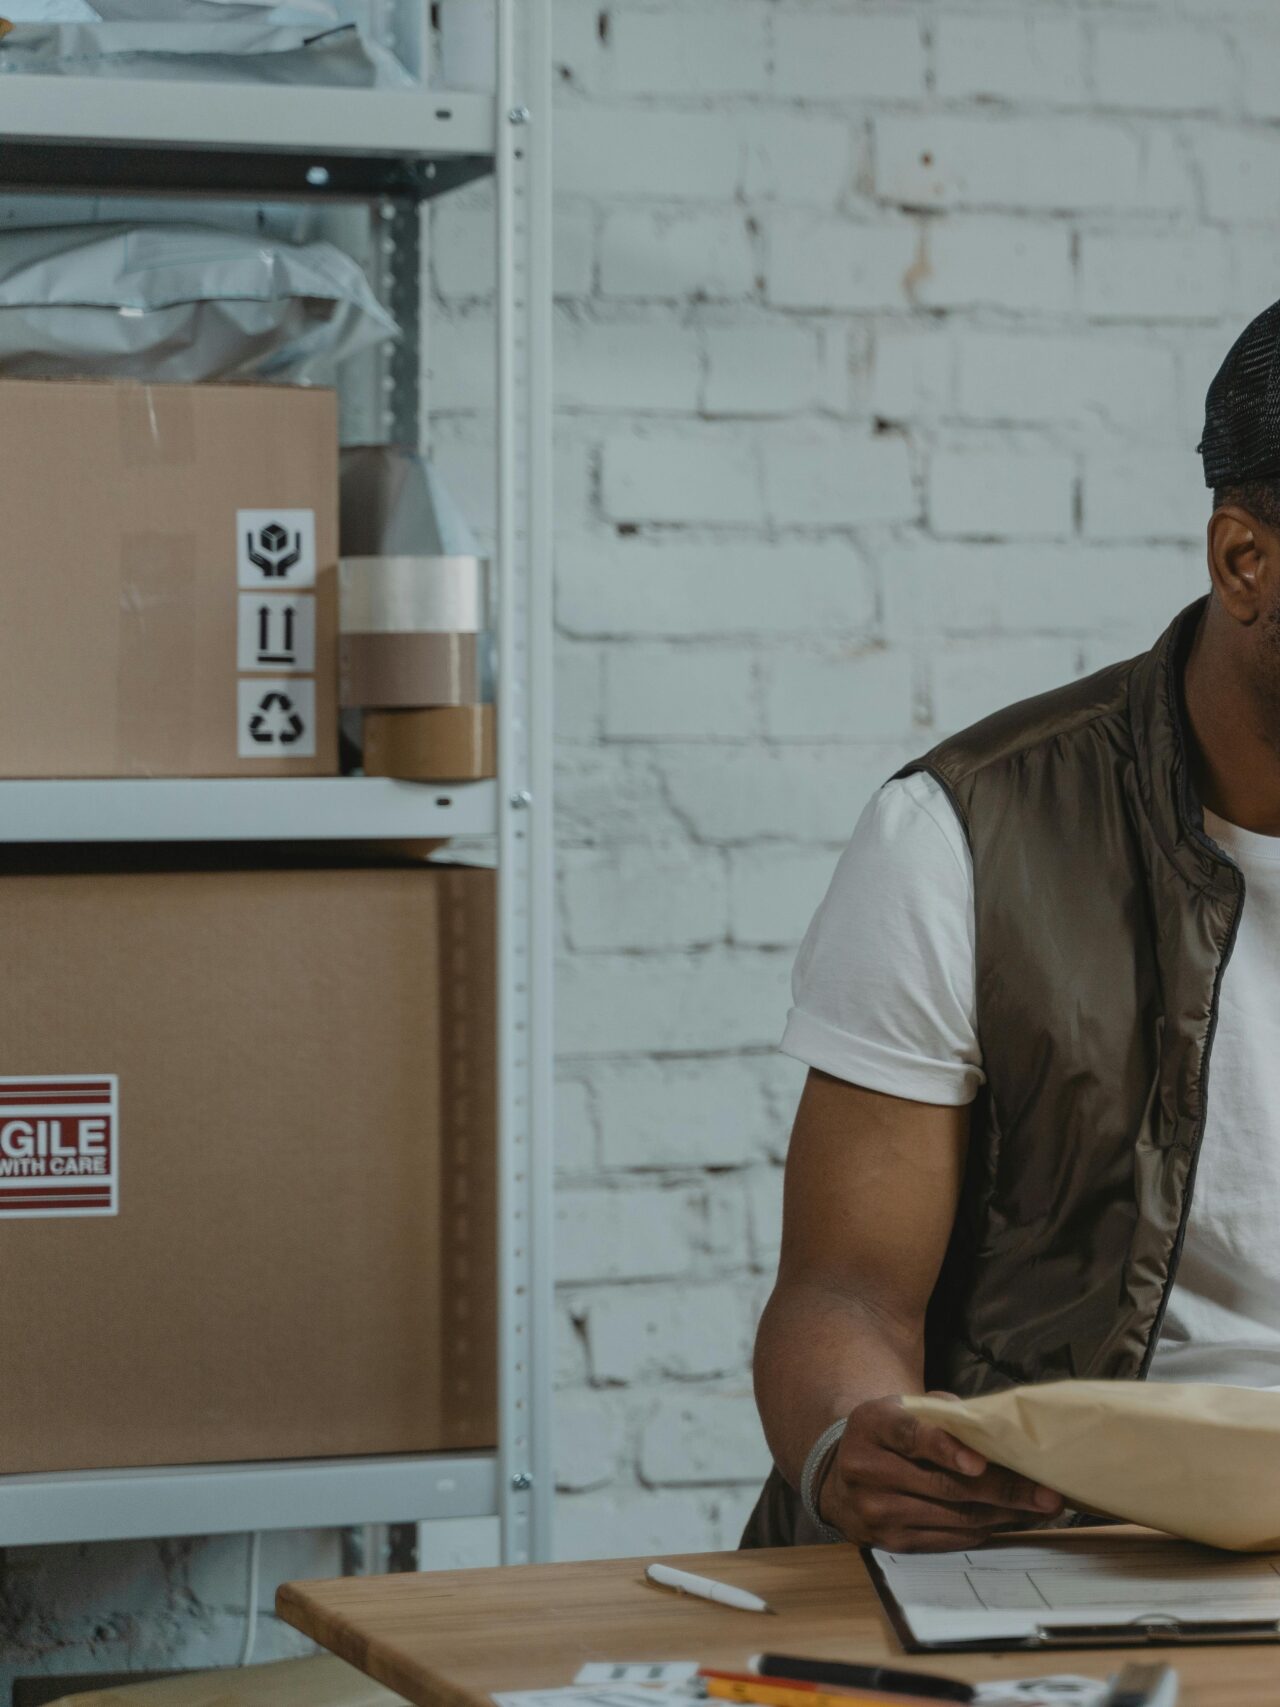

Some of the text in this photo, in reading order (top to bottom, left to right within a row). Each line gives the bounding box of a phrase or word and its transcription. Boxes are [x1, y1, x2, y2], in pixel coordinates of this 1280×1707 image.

[1, 1119, 106, 1157] GILE
[0, 1154, 106, 1176] WITH CARE
